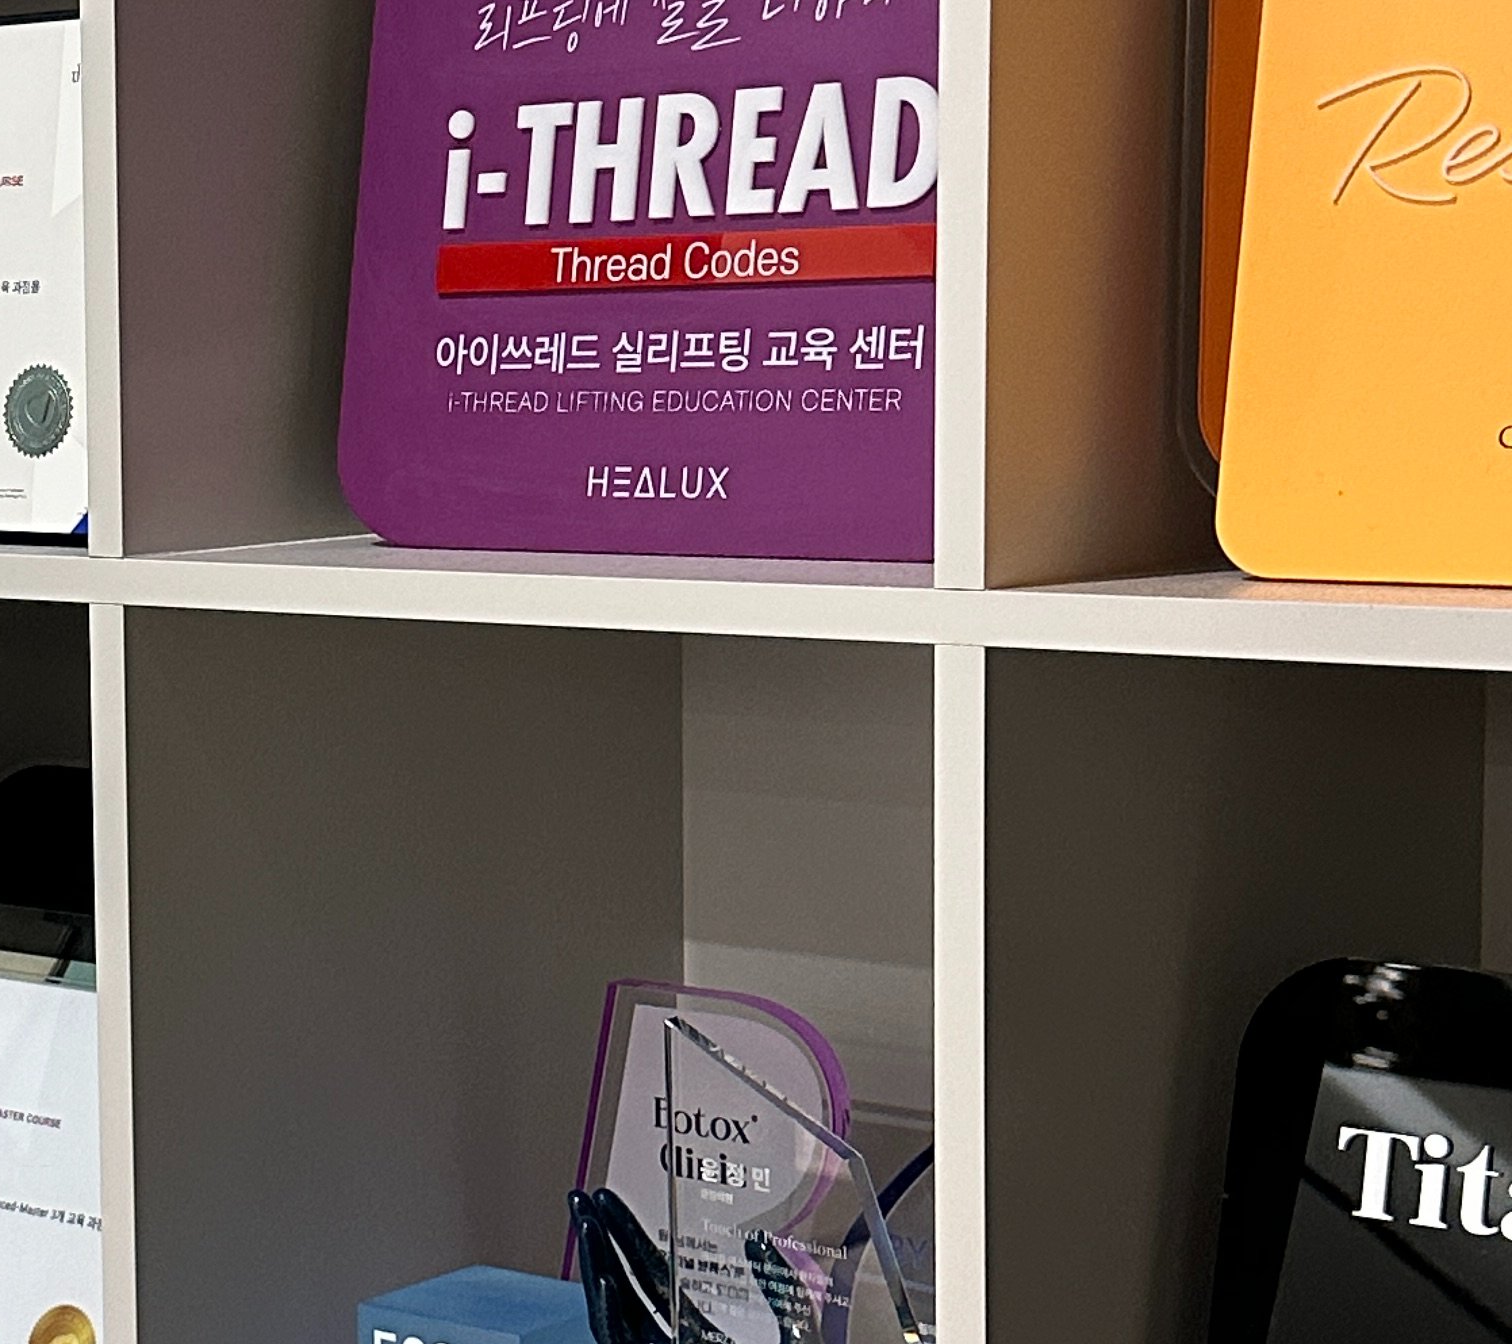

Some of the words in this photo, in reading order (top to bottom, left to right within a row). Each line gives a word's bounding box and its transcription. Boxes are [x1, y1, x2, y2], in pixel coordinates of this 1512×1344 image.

[1315, 65, 1512, 205] Re
[440, 75, 939, 232] i-THREAD
[550, 243, 672, 287] Thread
[682, 240, 801, 281] Codes
[435, 331, 601, 376] 아이쓰레드
[611, 327, 753, 375] 실리프팅
[762, 327, 839, 372] 교육
[848, 324, 926, 372] 센터
[447, 390, 549, 414] i-THREAD
[555, 389, 645, 414] LIFTING
[652, 388, 793, 413] EDUCATION
[800, 387, 903, 412] CENTER
[586, 465, 730, 500] HEALUX
[26, 1112, 62, 1130] COURSE
[751, 1167, 771, 1193] 민
[762, 1230, 848, 1261] Professional
